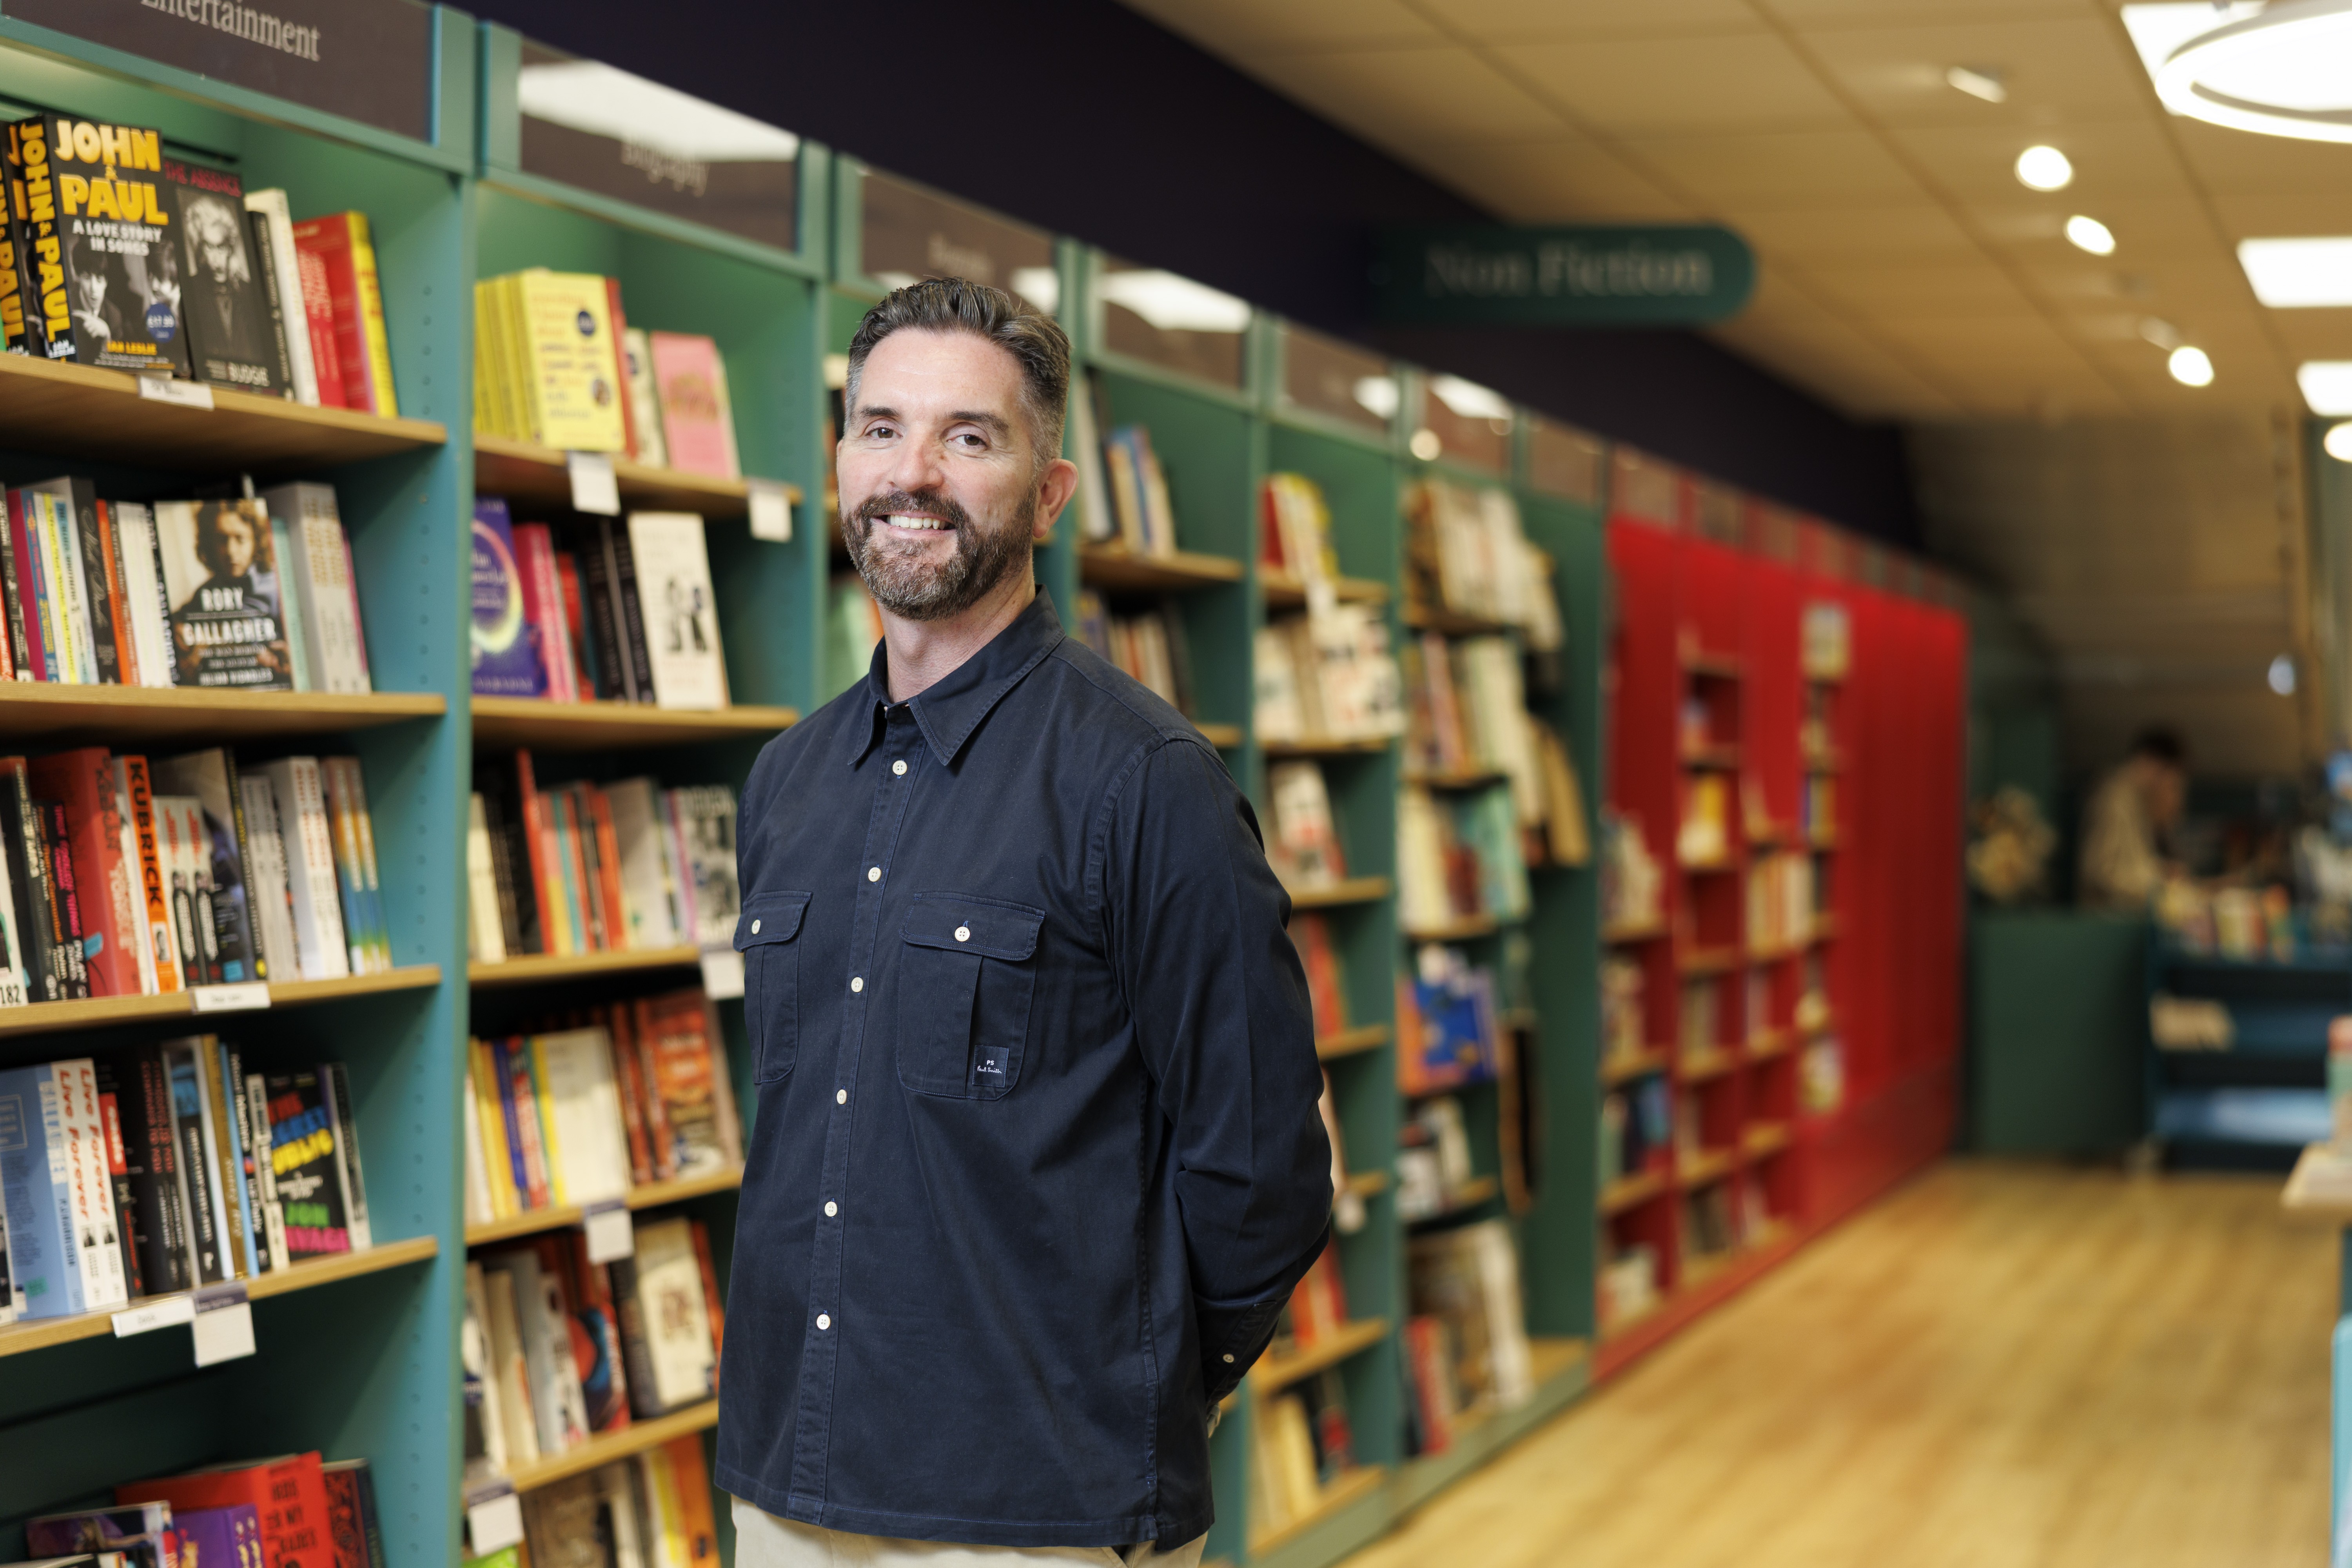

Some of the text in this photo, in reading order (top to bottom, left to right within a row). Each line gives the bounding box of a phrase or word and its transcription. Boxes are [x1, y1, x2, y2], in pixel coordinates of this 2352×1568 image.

[54, 119, 162, 172] JOHN
[104, 163, 117, 181] &
[59, 173, 169, 226] PAUL
[20, 122, 71, 343] JOHN & PAUL
[72, 219, 162, 243] A LOVE STORY
[90, 236, 150, 257] IN SONGS
[1425, 239, 1713, 298] Non Fiction
[106, 340, 157, 355] IAN LESLIE
[201, 586, 244, 612] RORY
[182, 617, 277, 646] GALLAGHER
[130, 762, 163, 908] KUBRICK
[0, 985, 21, 1004] 182
[60, 1069, 89, 1220] Live Forever
[80, 1067, 109, 1216] Live Forever
